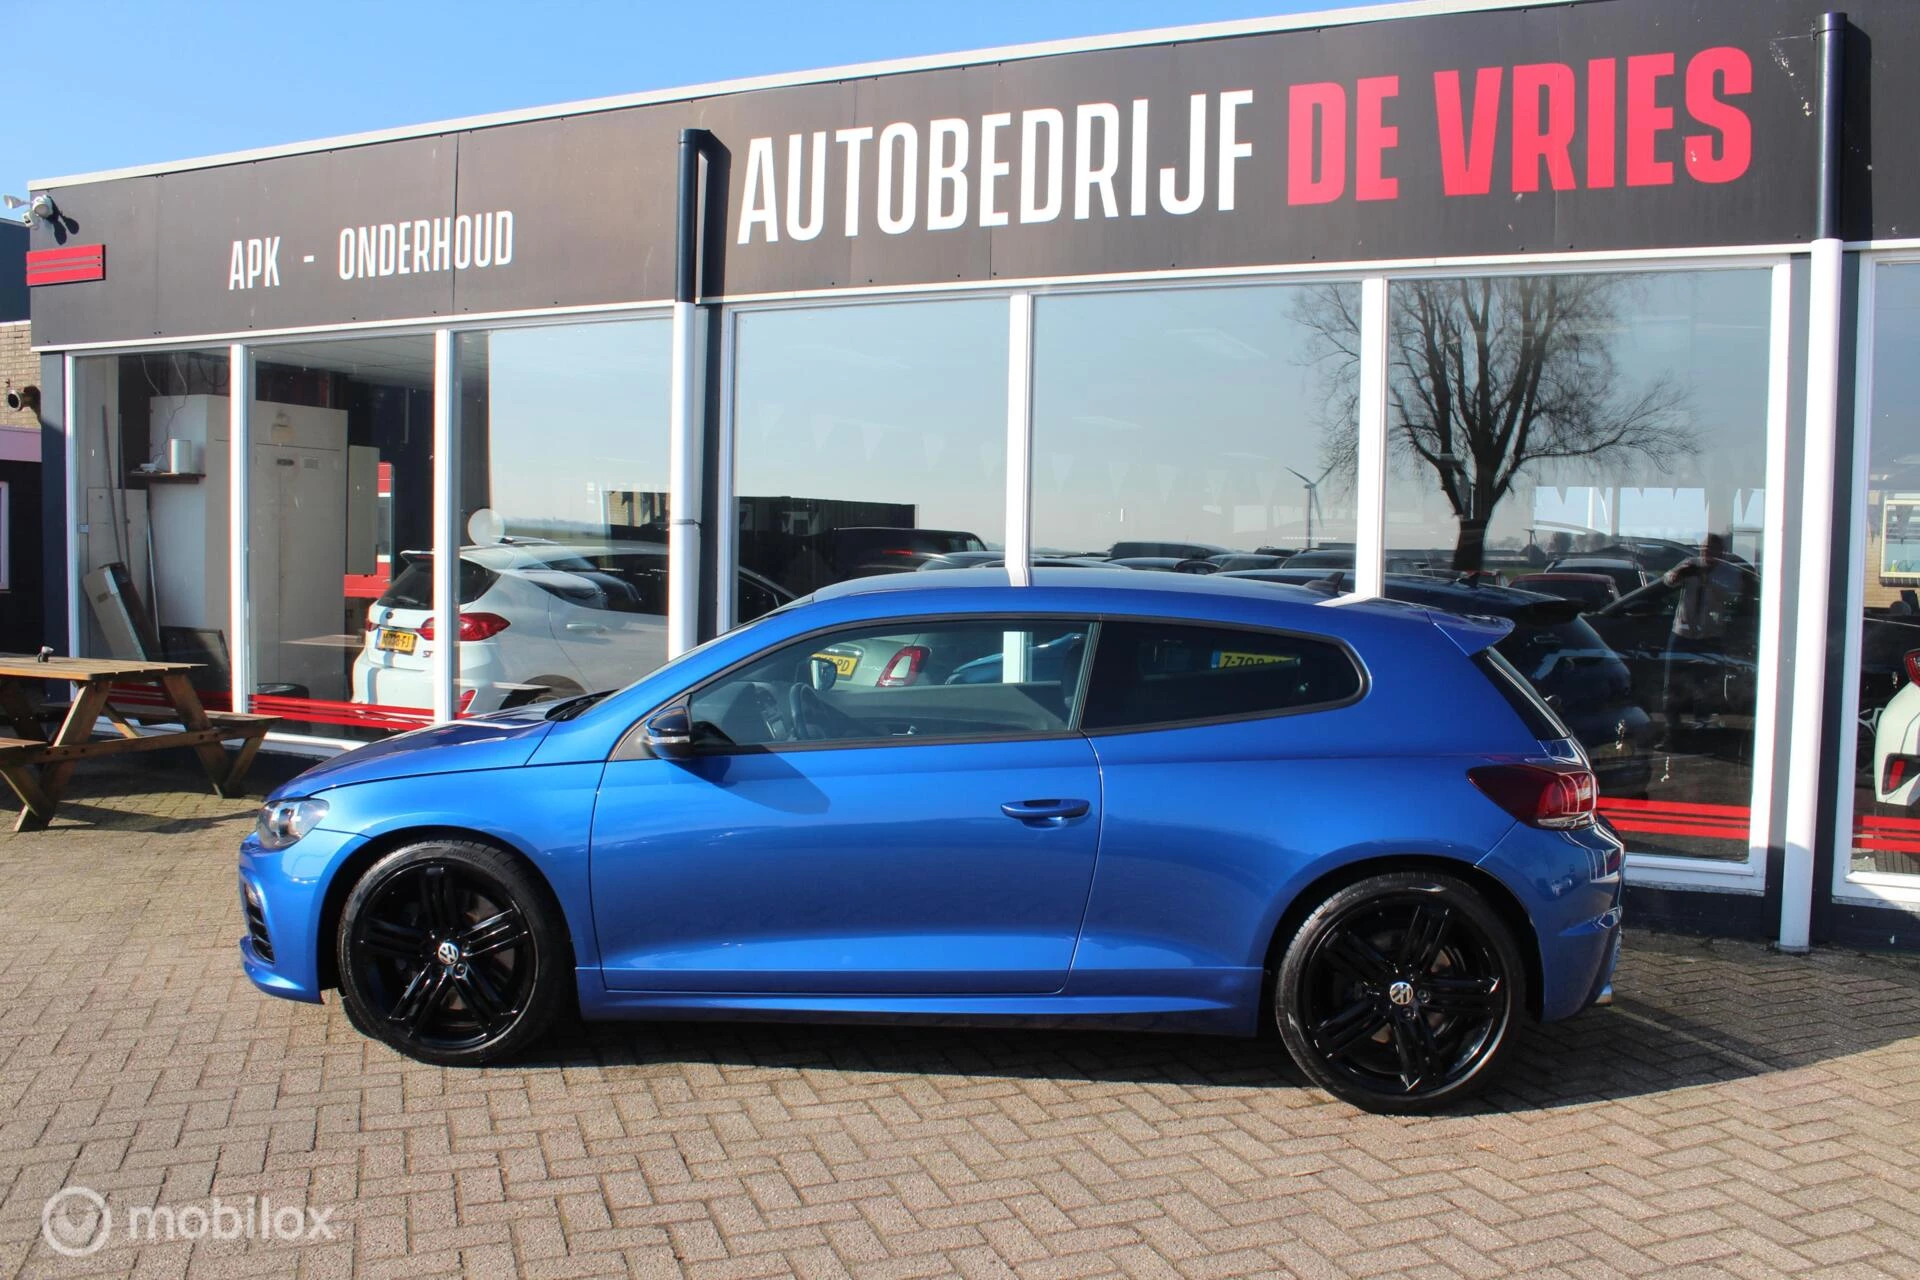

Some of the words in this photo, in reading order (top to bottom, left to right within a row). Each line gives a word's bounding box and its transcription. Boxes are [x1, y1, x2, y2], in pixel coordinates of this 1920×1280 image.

[737, 89, 1254, 244] AUTOBEDRIJF
[1288, 75, 1399, 207] DE
[1433, 46, 1753, 197] VRIES
[228, 236, 281, 291] APK
[338, 209, 514, 281] ONDERHOUD
